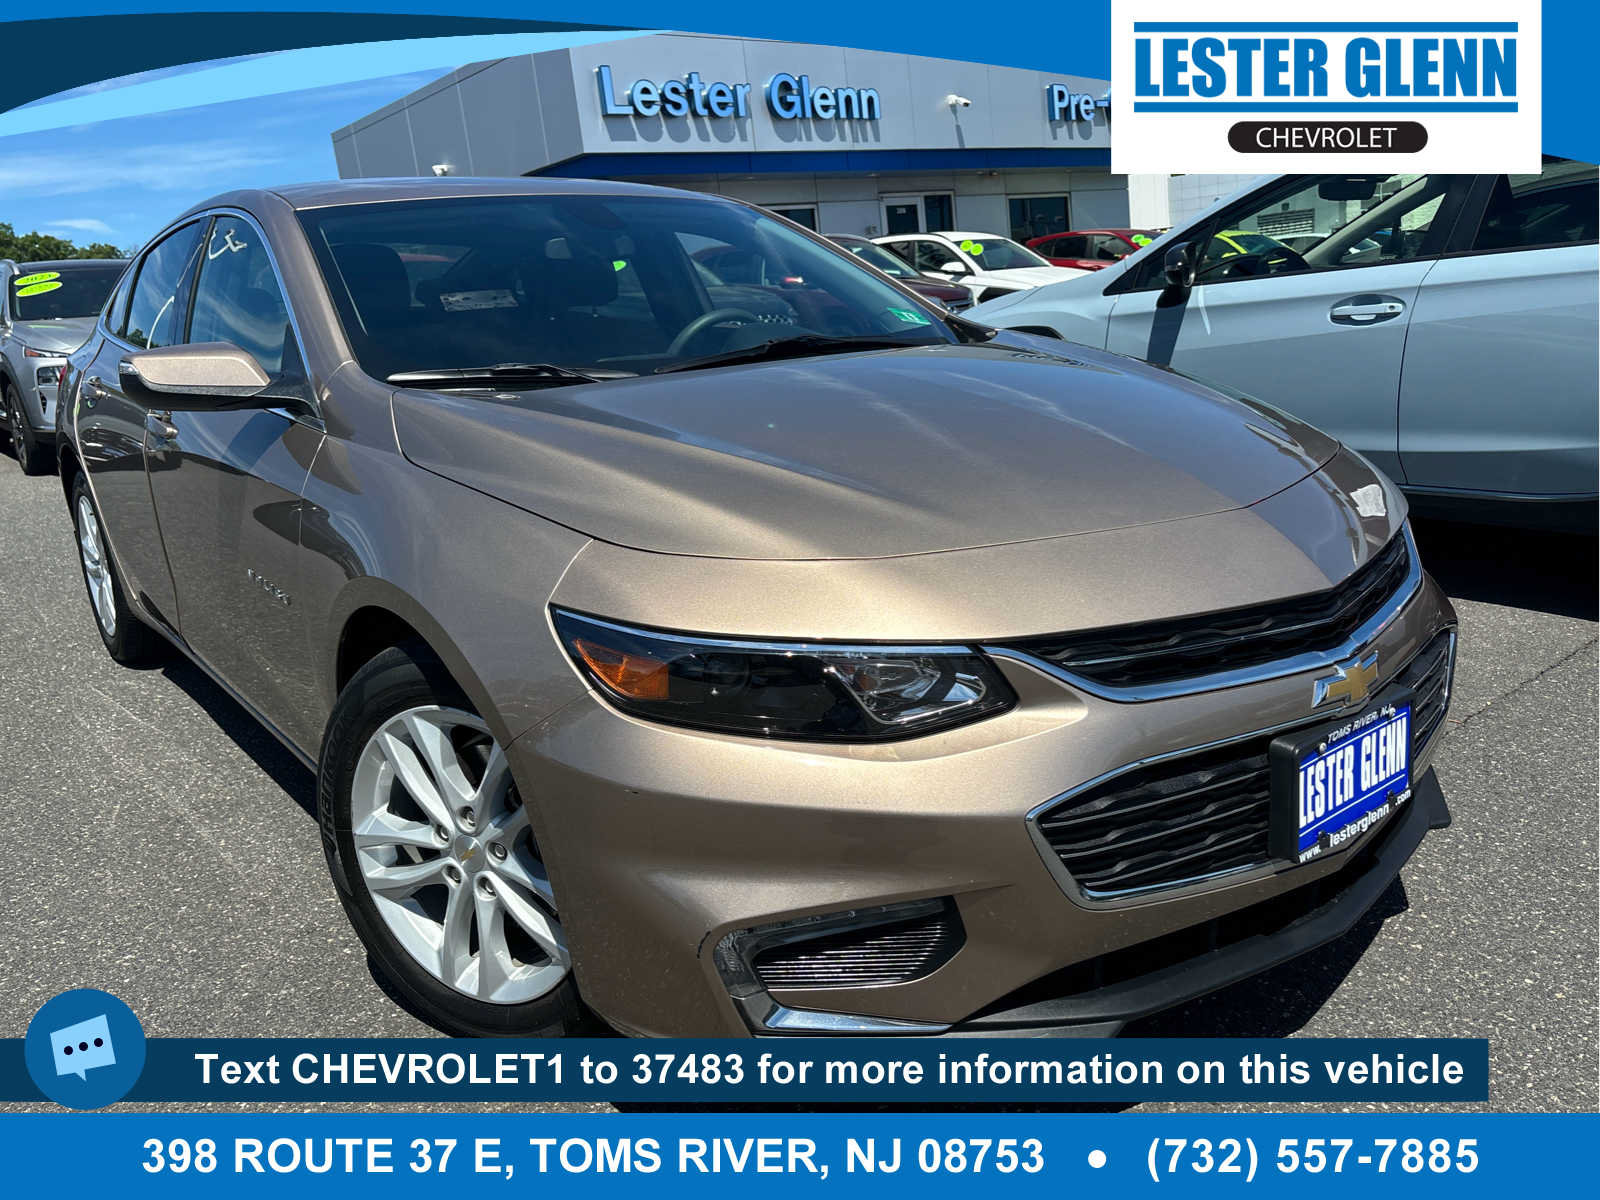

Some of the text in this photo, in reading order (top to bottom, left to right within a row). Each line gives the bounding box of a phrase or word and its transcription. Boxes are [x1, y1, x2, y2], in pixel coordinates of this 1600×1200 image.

[595, 64, 882, 121] Lester Glenn
[1328, 723, 1352, 744] TOMS
[1299, 716, 1407, 829] LESTER GLENN
